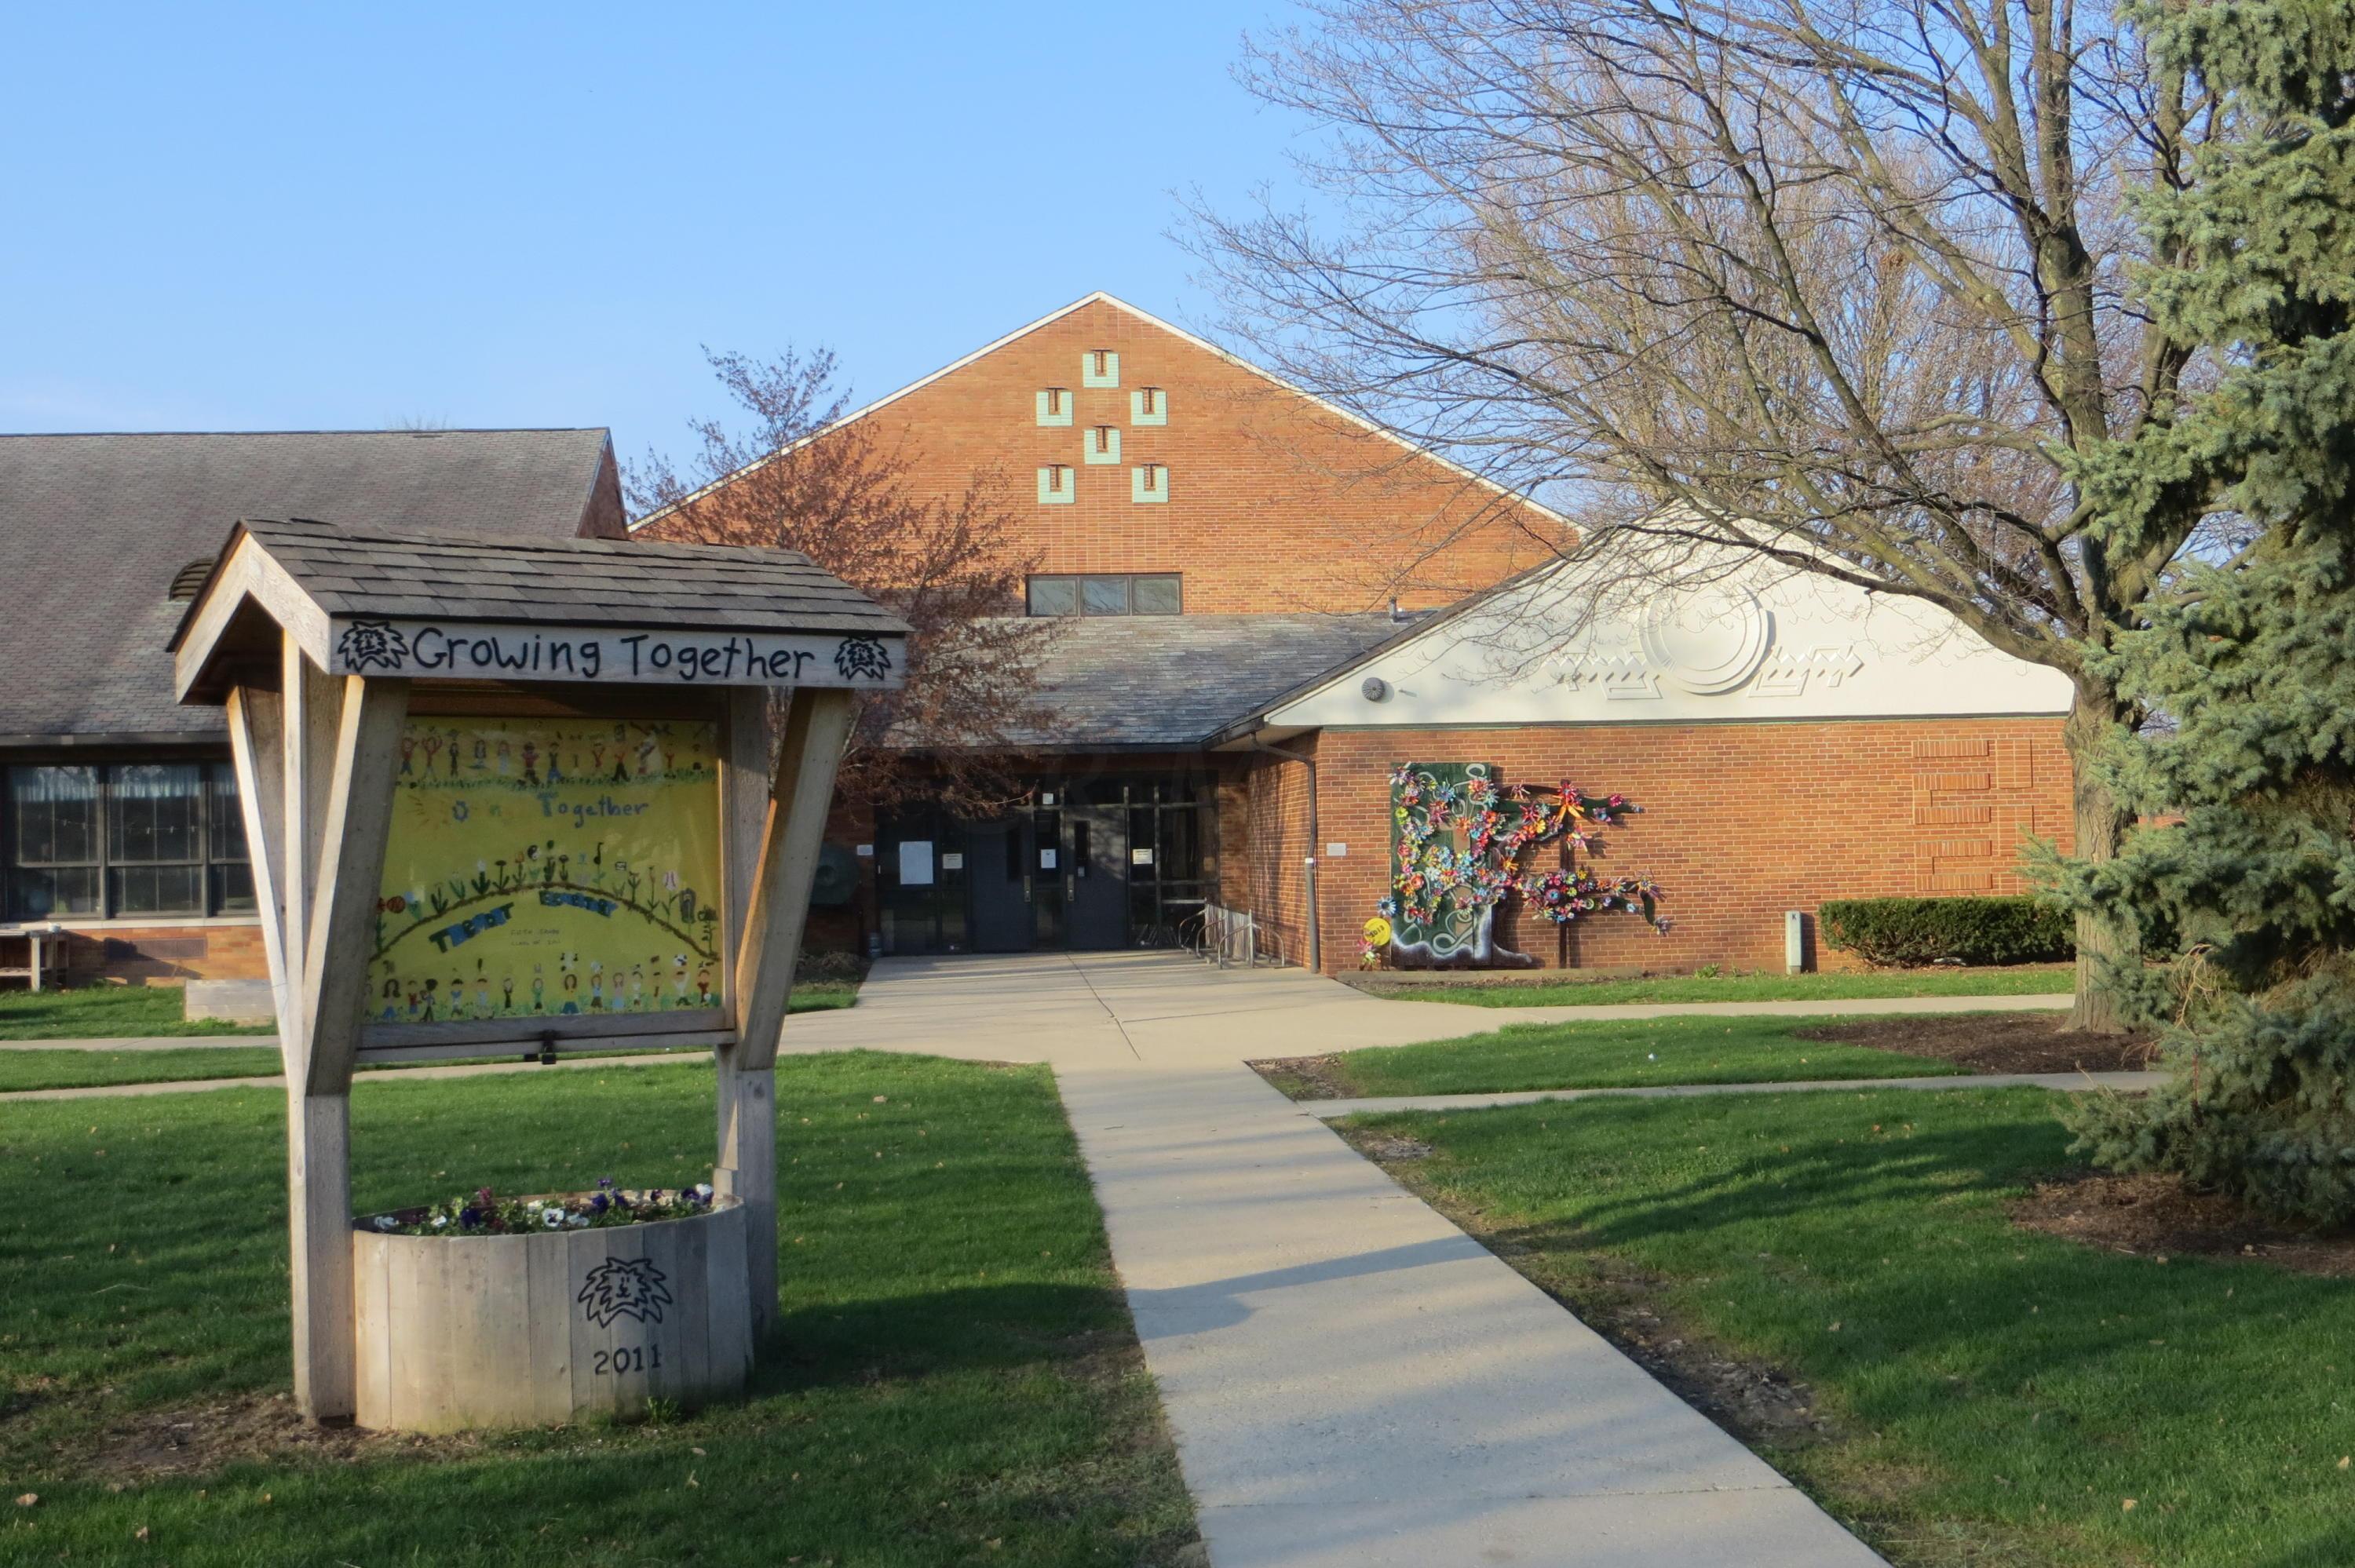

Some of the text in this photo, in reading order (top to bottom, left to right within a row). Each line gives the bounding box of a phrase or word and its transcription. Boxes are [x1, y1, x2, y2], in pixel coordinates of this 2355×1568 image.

[411, 628, 816, 680] Growing Together
[537, 791, 649, 829] Together
[593, 1344, 662, 1375] 2011
